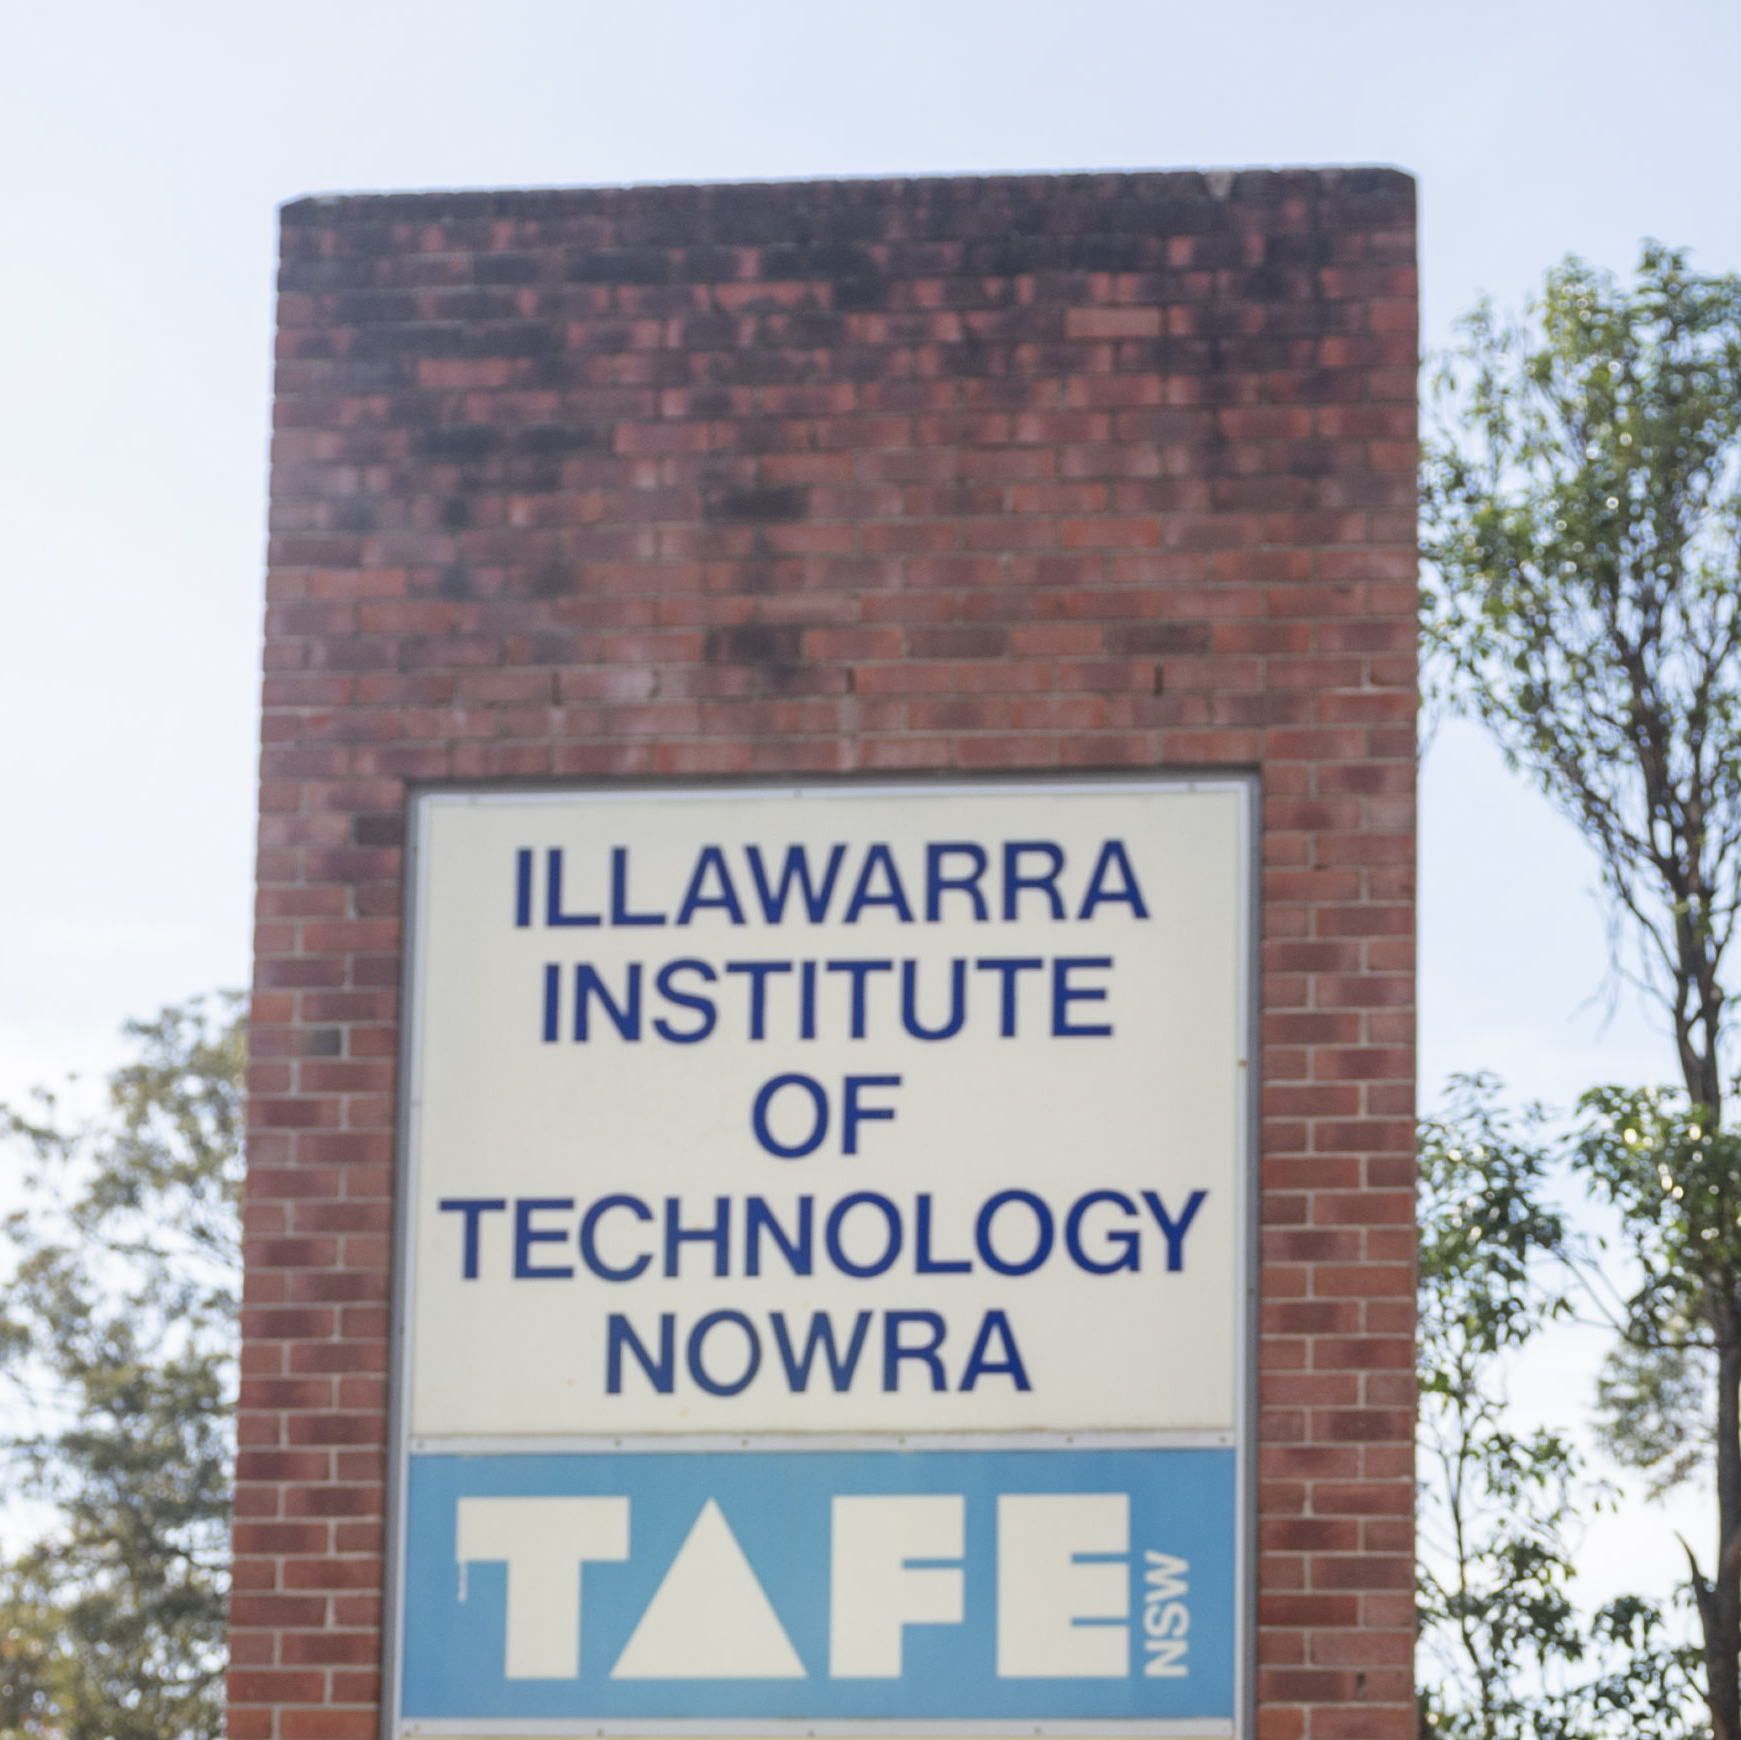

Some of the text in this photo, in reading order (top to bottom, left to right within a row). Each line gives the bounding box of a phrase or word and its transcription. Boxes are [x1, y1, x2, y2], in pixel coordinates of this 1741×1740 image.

[513, 839, 1151, 928] ILLAWARRA
[541, 956, 1114, 1043] INSTITUTE
[751, 1072, 902, 1159] OF
[439, 1188, 1209, 1282] TECHNOLOGY
[604, 1308, 1033, 1397] NOWRA
[456, 1493, 1129, 1680] TAFE
[1143, 1549, 1190, 1678] NSW
